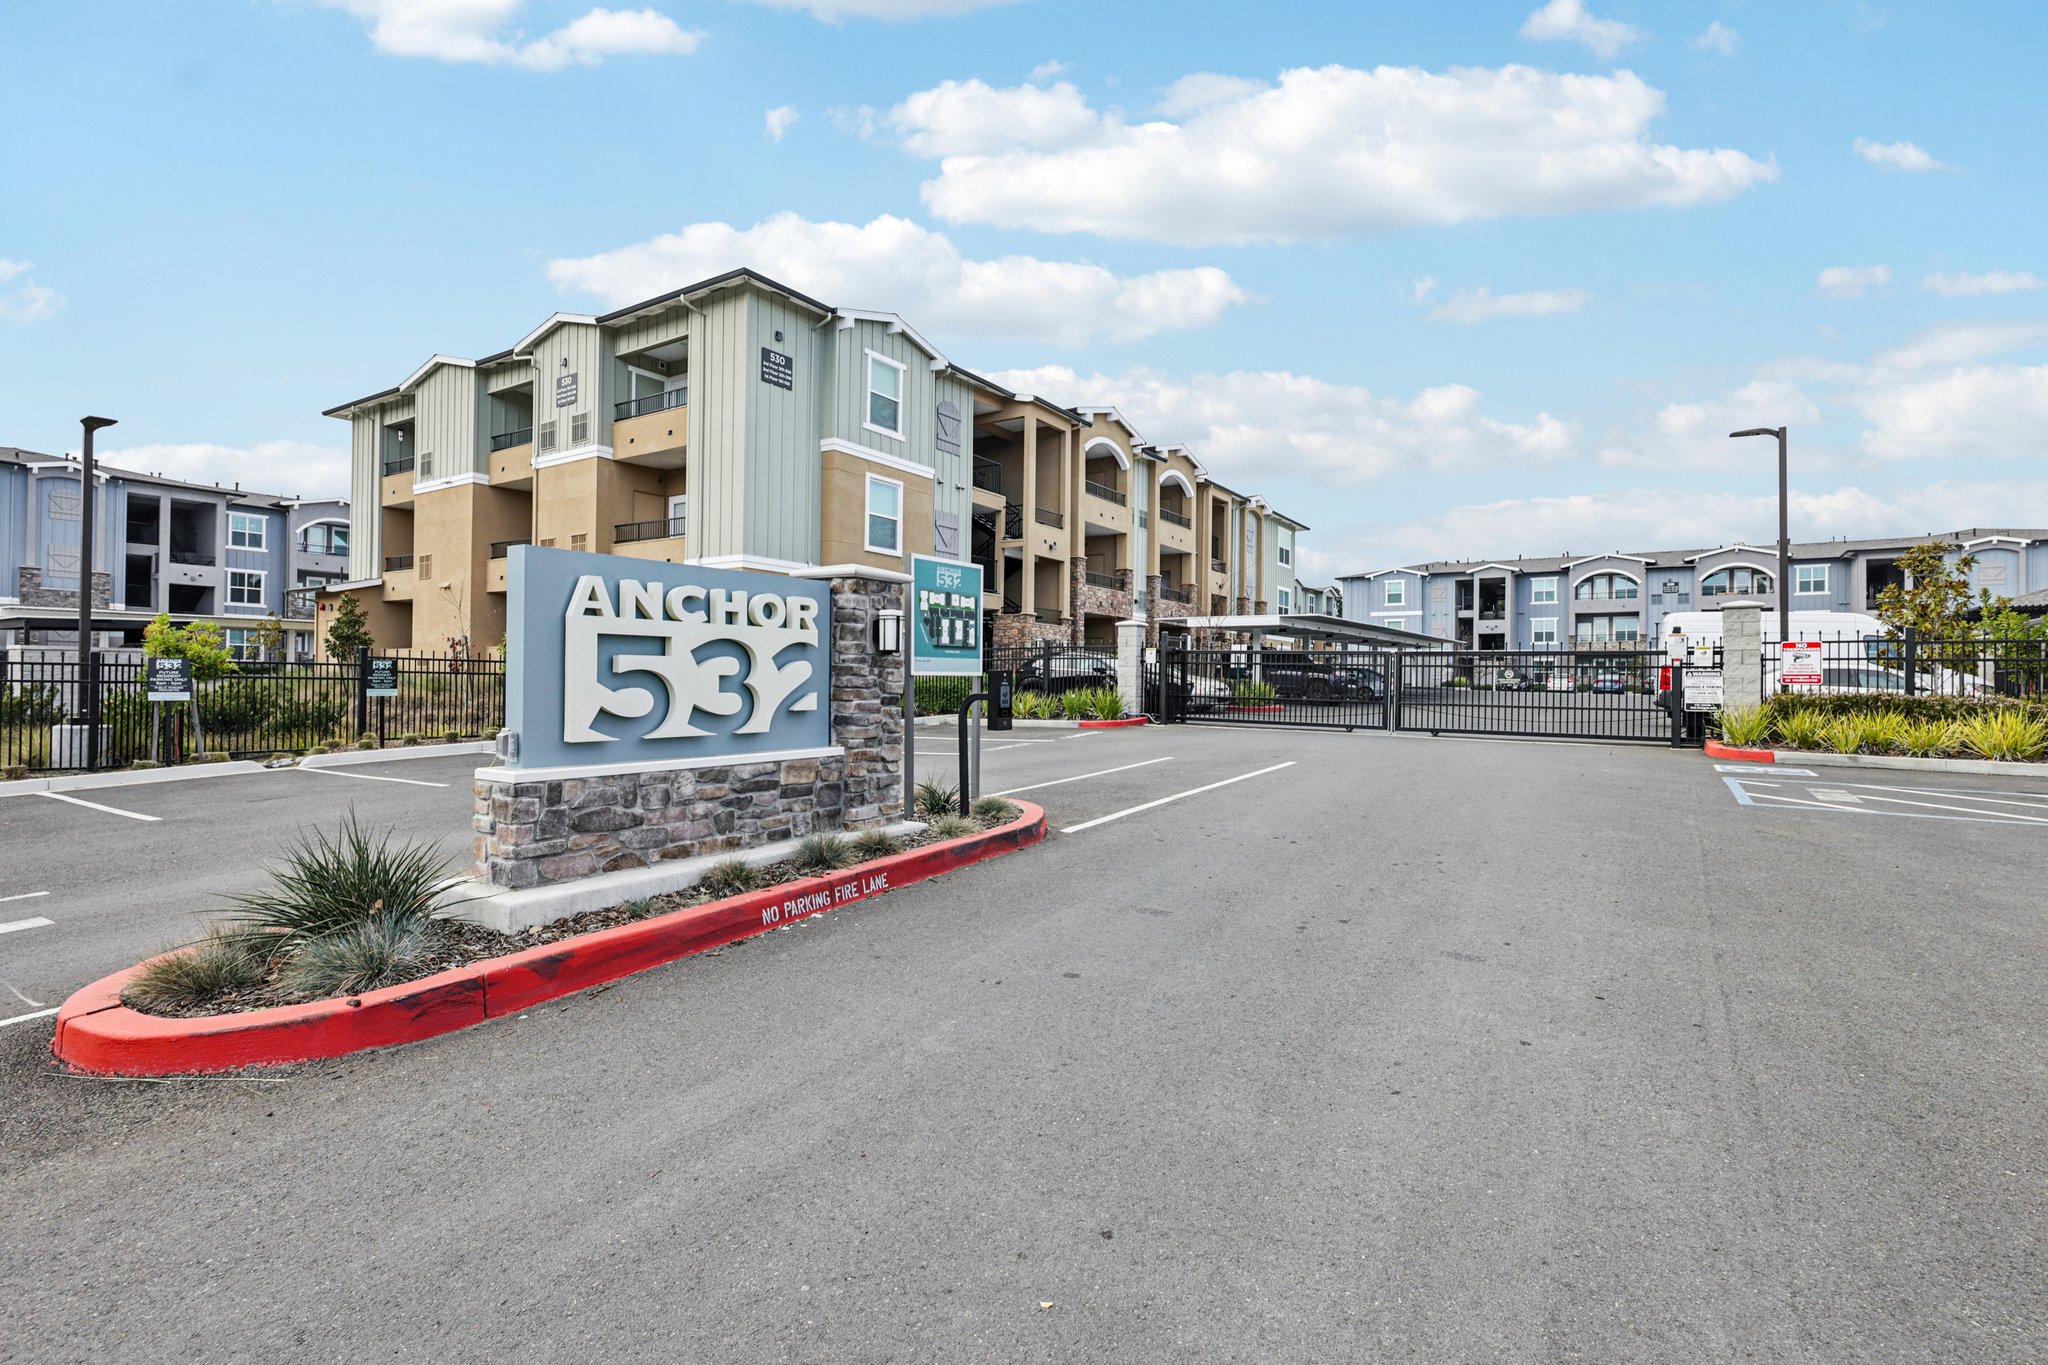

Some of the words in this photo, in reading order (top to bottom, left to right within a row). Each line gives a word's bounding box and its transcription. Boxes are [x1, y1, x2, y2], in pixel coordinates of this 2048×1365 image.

[770, 352, 786, 365] 530
[561, 376, 572, 386] 530
[936, 566, 962, 577] ANCHOR
[936, 574, 962, 588] 532
[565, 574, 819, 630] ANCHOR
[585, 630, 819, 742] 532
[762, 905, 780, 926] NO
[784, 890, 831, 919] PARKING
[834, 881, 860, 903] FIRE
[862, 872, 889, 894] LANE
